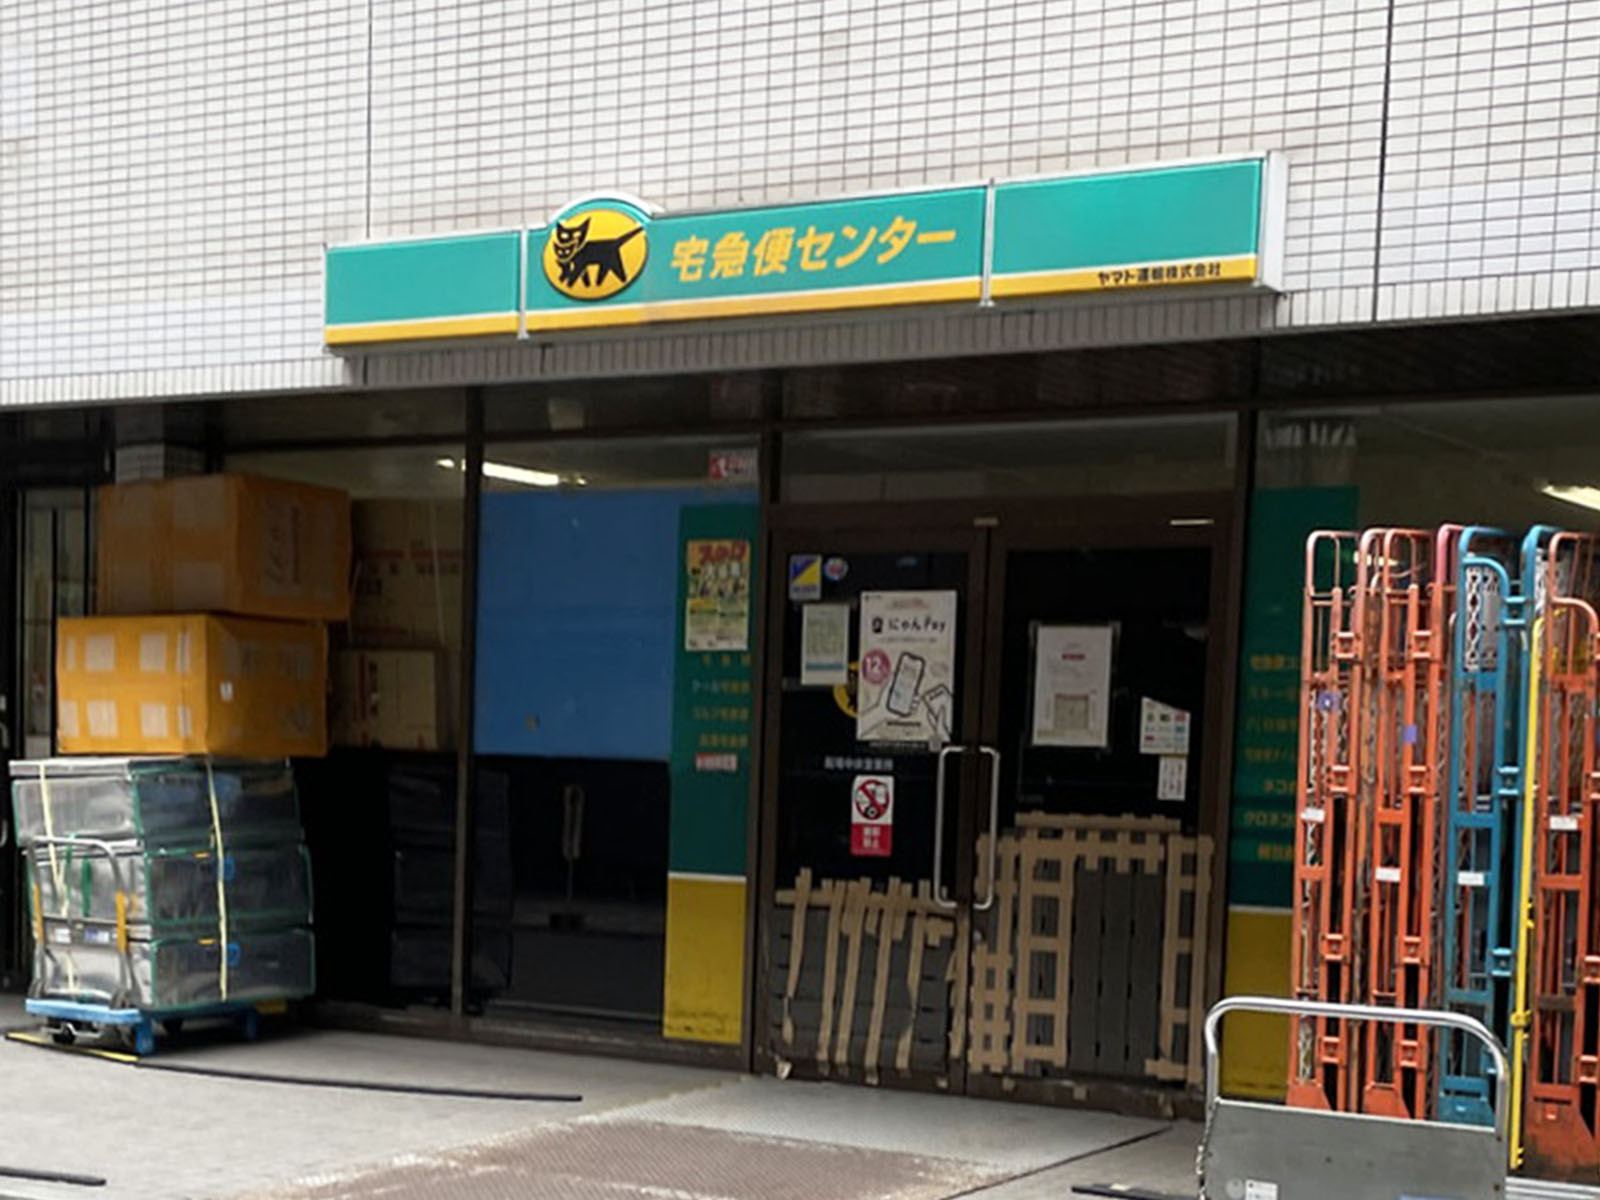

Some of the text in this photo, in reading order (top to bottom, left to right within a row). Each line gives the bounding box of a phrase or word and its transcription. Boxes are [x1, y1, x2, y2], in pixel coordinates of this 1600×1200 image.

[670, 215, 957, 282] 宅急便センター
